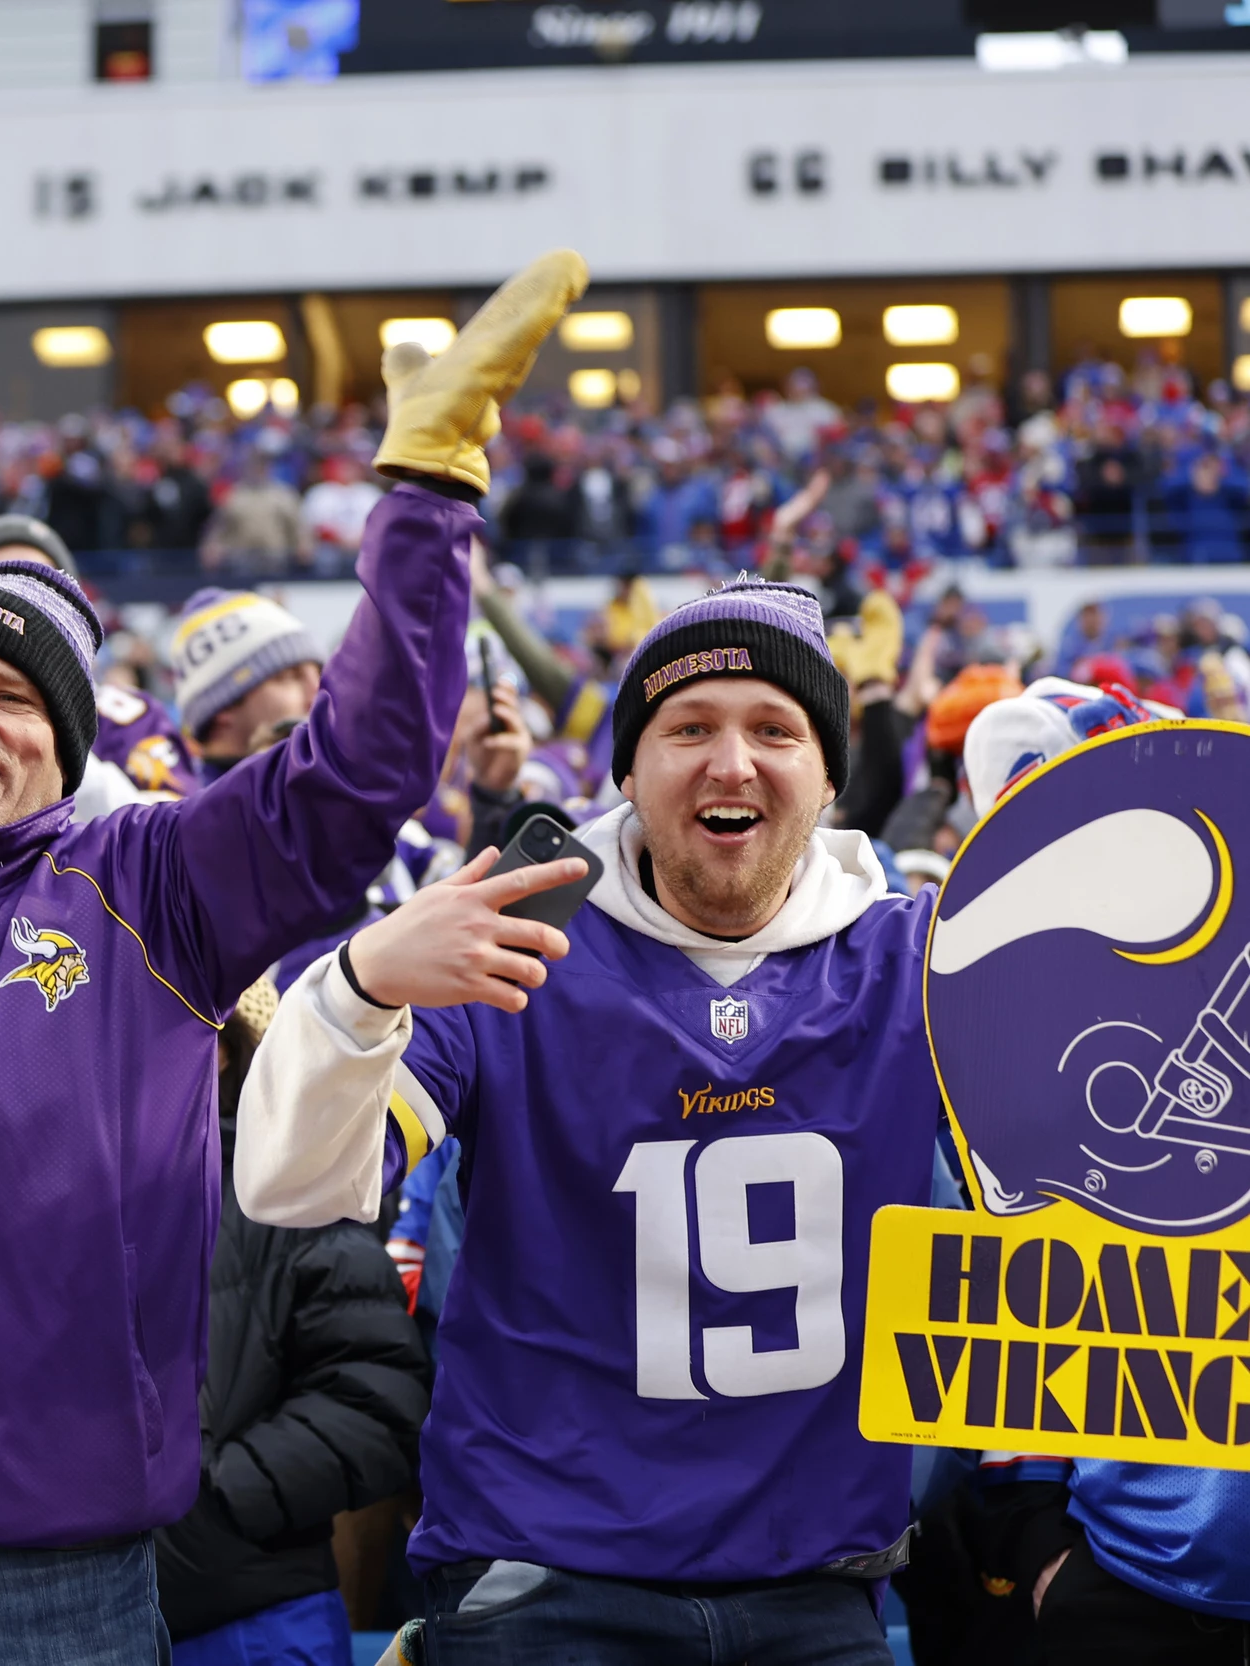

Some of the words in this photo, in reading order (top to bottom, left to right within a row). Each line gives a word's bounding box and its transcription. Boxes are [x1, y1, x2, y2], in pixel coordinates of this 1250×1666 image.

[138, 170, 322, 214] JACK
[359, 166, 550, 200] KEMP
[879, 151, 1051, 186] BILLY
[1096, 150, 1250, 181] SHA
[643, 647, 753, 702] MINNESOTA
[718, 1018, 743, 1036] NFL
[612, 1131, 846, 1400] 19
